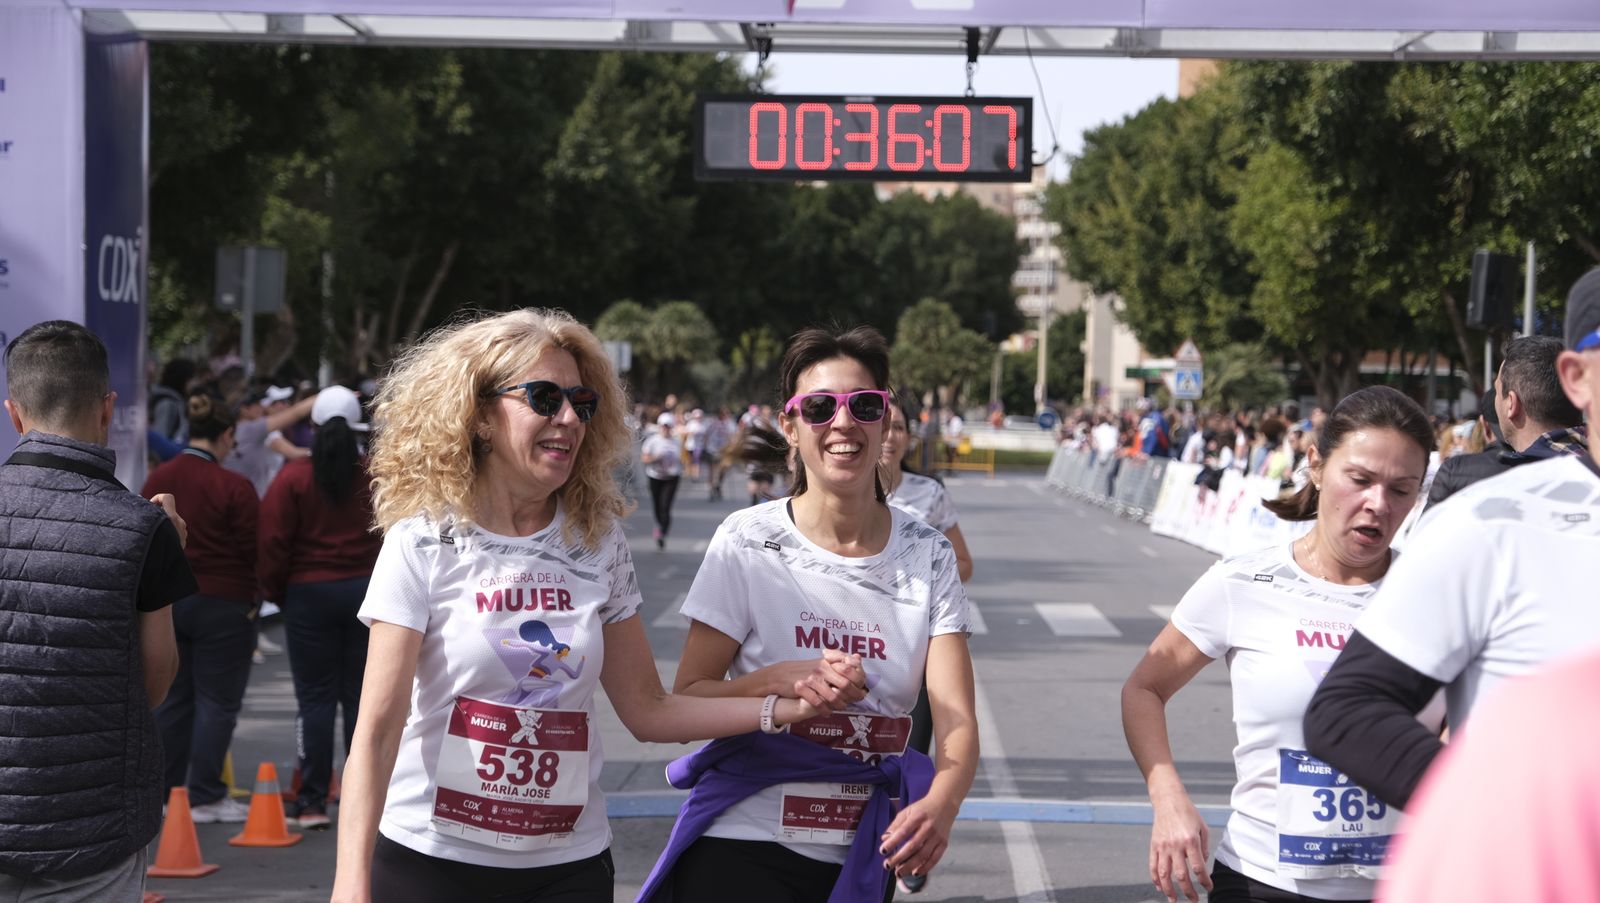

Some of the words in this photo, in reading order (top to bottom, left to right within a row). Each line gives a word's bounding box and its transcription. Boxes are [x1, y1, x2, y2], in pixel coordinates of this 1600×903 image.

[749, 102, 1016, 172] 00:36:07
[480, 573, 536, 588] CARRERA
[538, 573, 552, 583] DE
[554, 574, 567, 584] LA
[476, 588, 575, 613] MUJER
[850, 621, 865, 632] DE
[867, 623, 881, 634] LA
[795, 626, 886, 660] MUJER
[471, 716, 507, 732] MUJER
[810, 727, 843, 737] MUJER
[476, 745, 560, 788] 538
[1298, 764, 1332, 775] MUJER
[481, 782, 519, 797] MARÍA
[522, 788, 551, 799] JOSÉ
[841, 784, 869, 795] IRENE
[1312, 788, 1386, 822] 365
[1342, 823, 1363, 832] LAU
